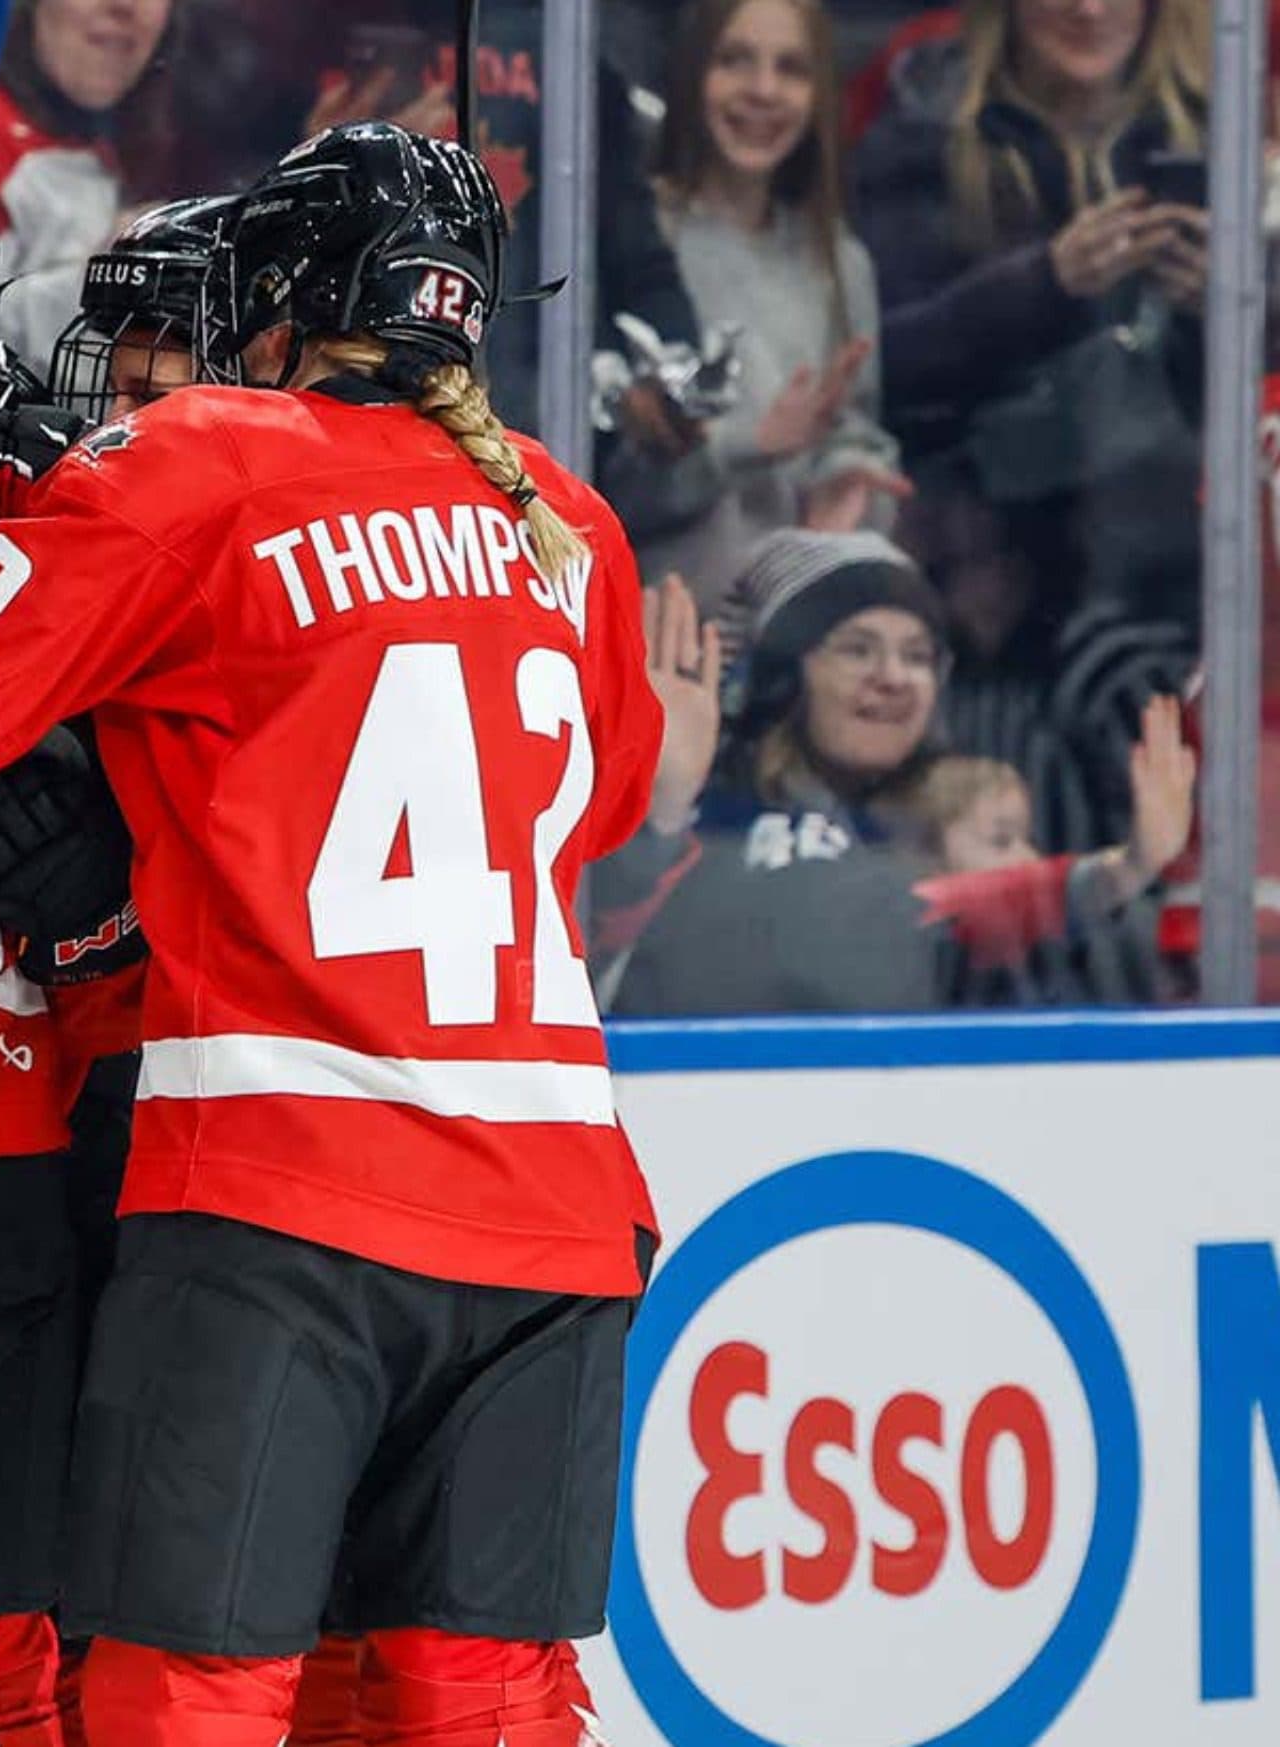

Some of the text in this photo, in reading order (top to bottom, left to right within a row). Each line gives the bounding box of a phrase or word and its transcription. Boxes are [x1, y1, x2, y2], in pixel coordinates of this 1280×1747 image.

[417, 271, 466, 322] 42
[252, 504, 594, 650] THOMPS
[307, 643, 602, 1028] 42
